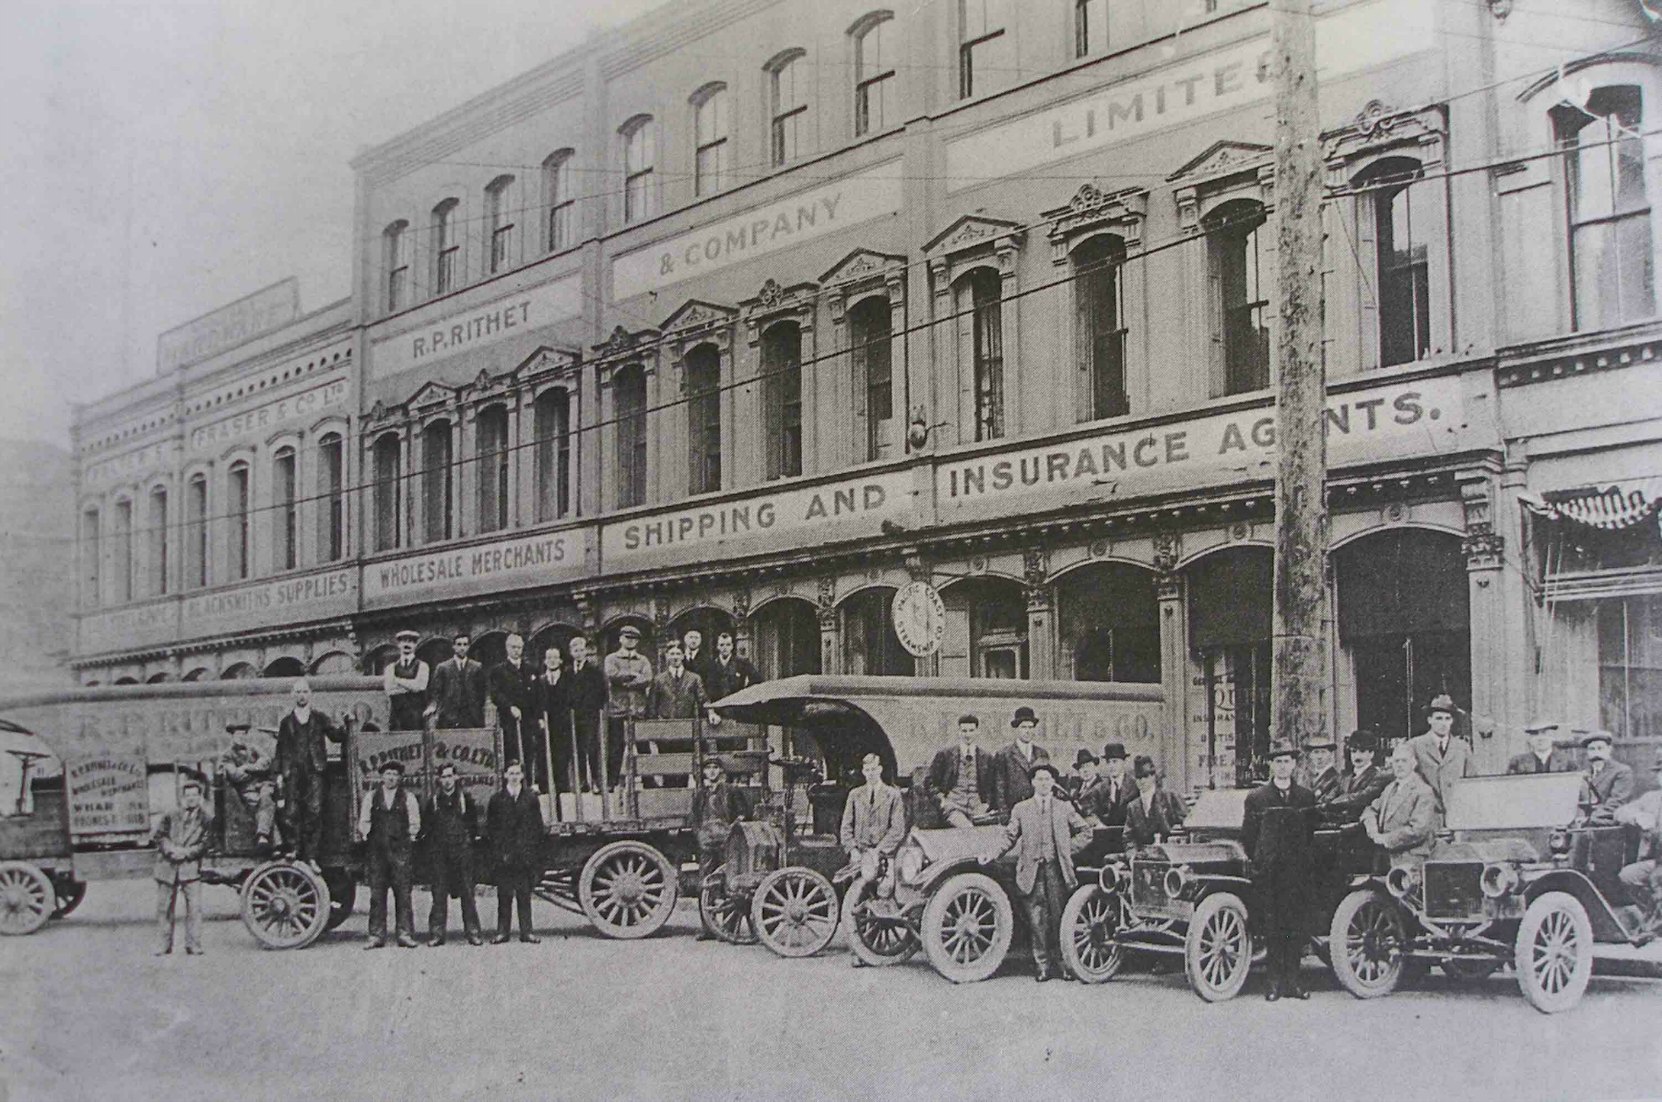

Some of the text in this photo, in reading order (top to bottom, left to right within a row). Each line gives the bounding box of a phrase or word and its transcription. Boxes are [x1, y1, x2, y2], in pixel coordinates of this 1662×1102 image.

[659, 192, 843, 276] & COMPANY
[193, 408, 270, 448] FRASER
[624, 392, 1442, 552] SHIPPING AND INSURANCE AGNTS.
[380, 540, 565, 588] WHOLESALE MERCHANTS
[433, 741, 449, 759] &
